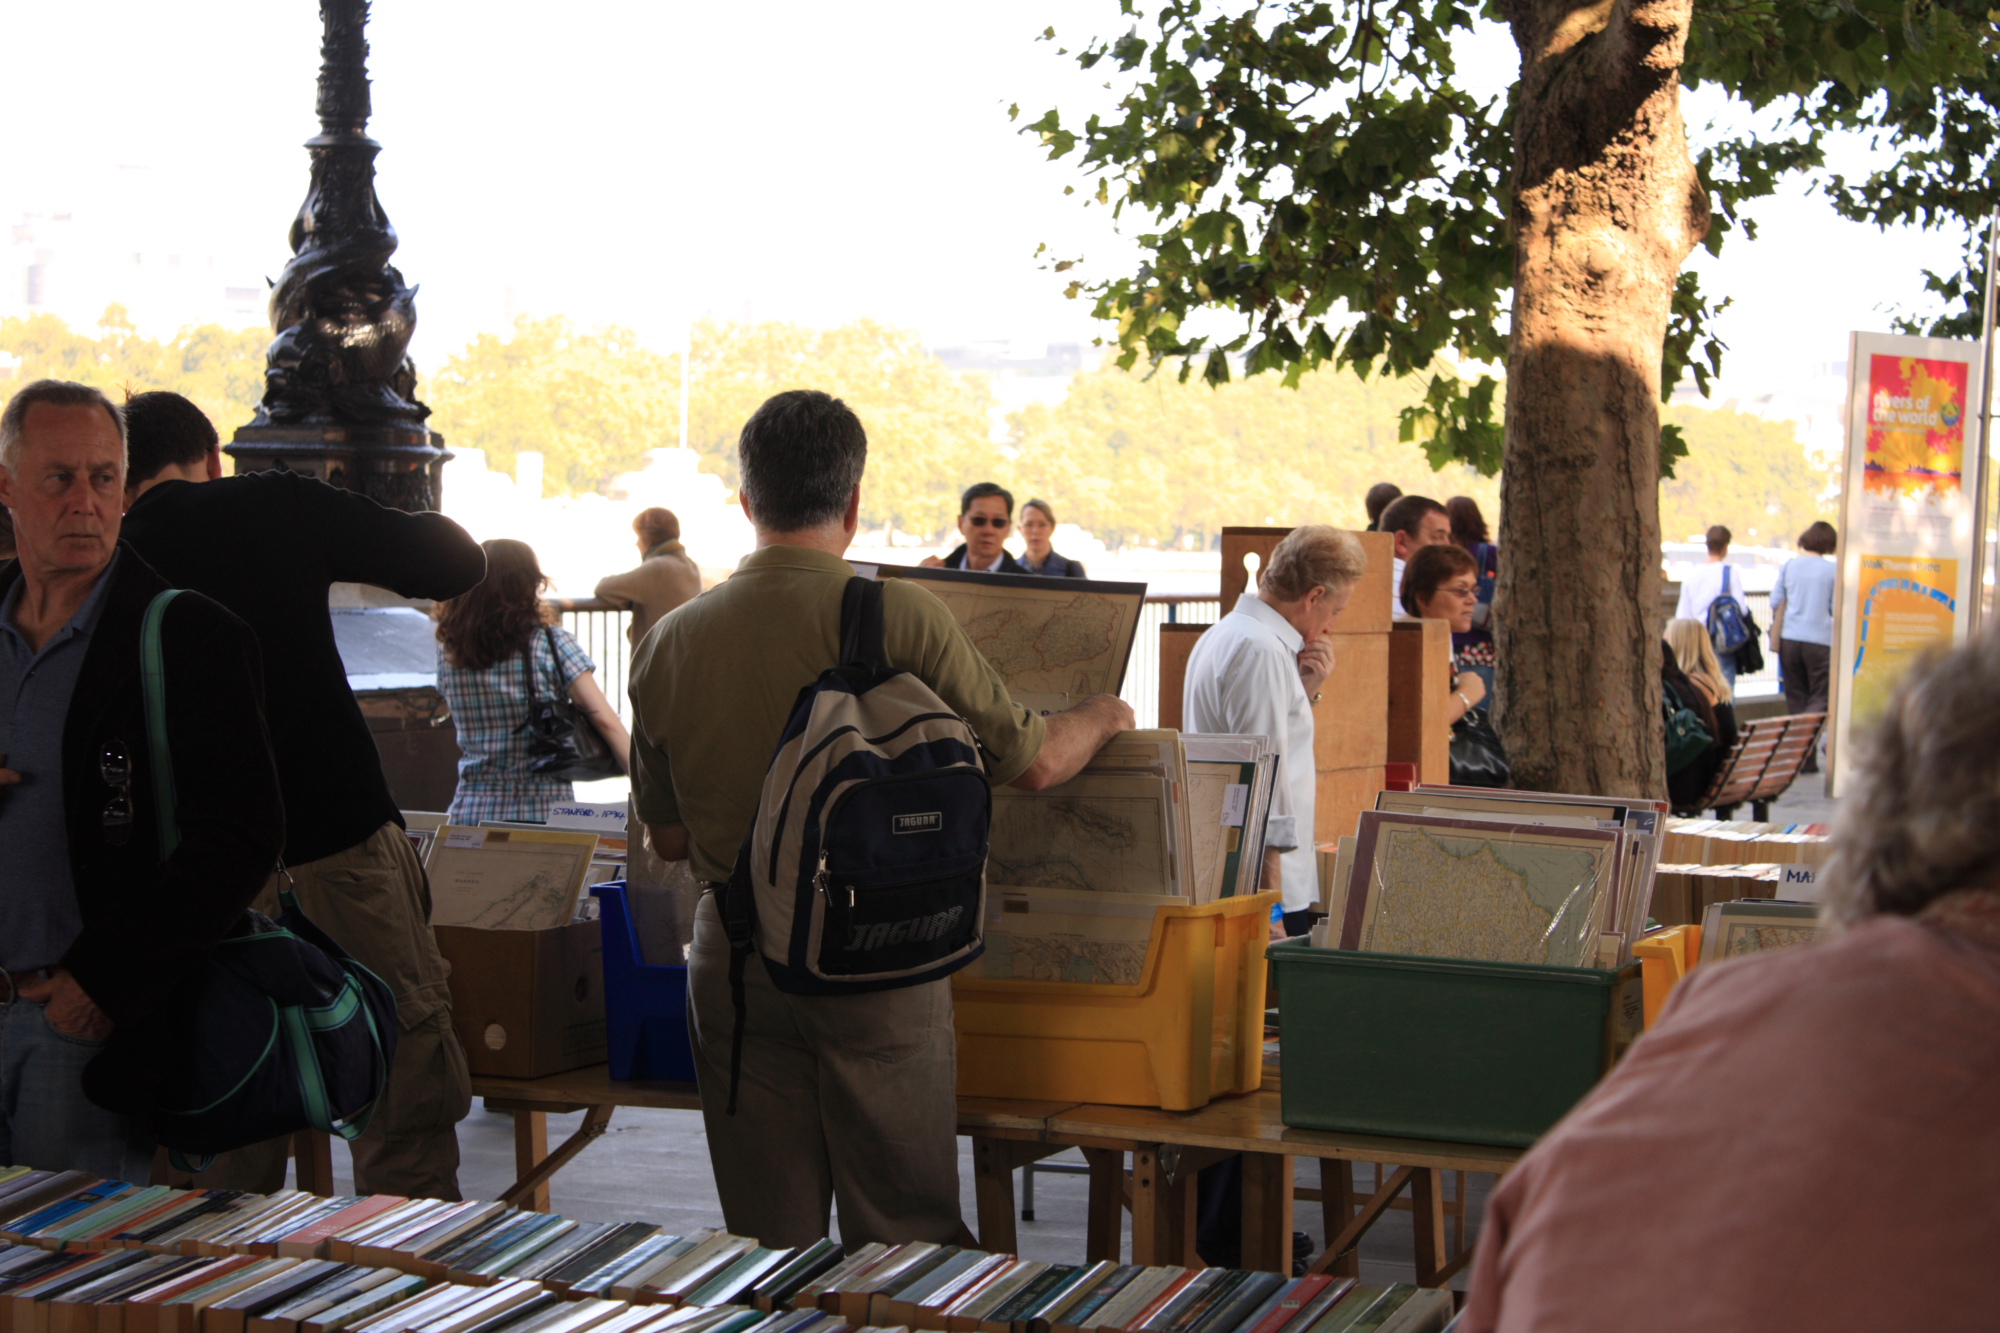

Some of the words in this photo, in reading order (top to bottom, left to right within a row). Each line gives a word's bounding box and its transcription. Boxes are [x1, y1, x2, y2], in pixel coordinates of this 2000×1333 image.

[1915, 395, 1931, 410] of
[1897, 410, 1938, 426] world
[899, 815, 936, 827] JAGUAR
[843, 905, 964, 952] JAGUAR
